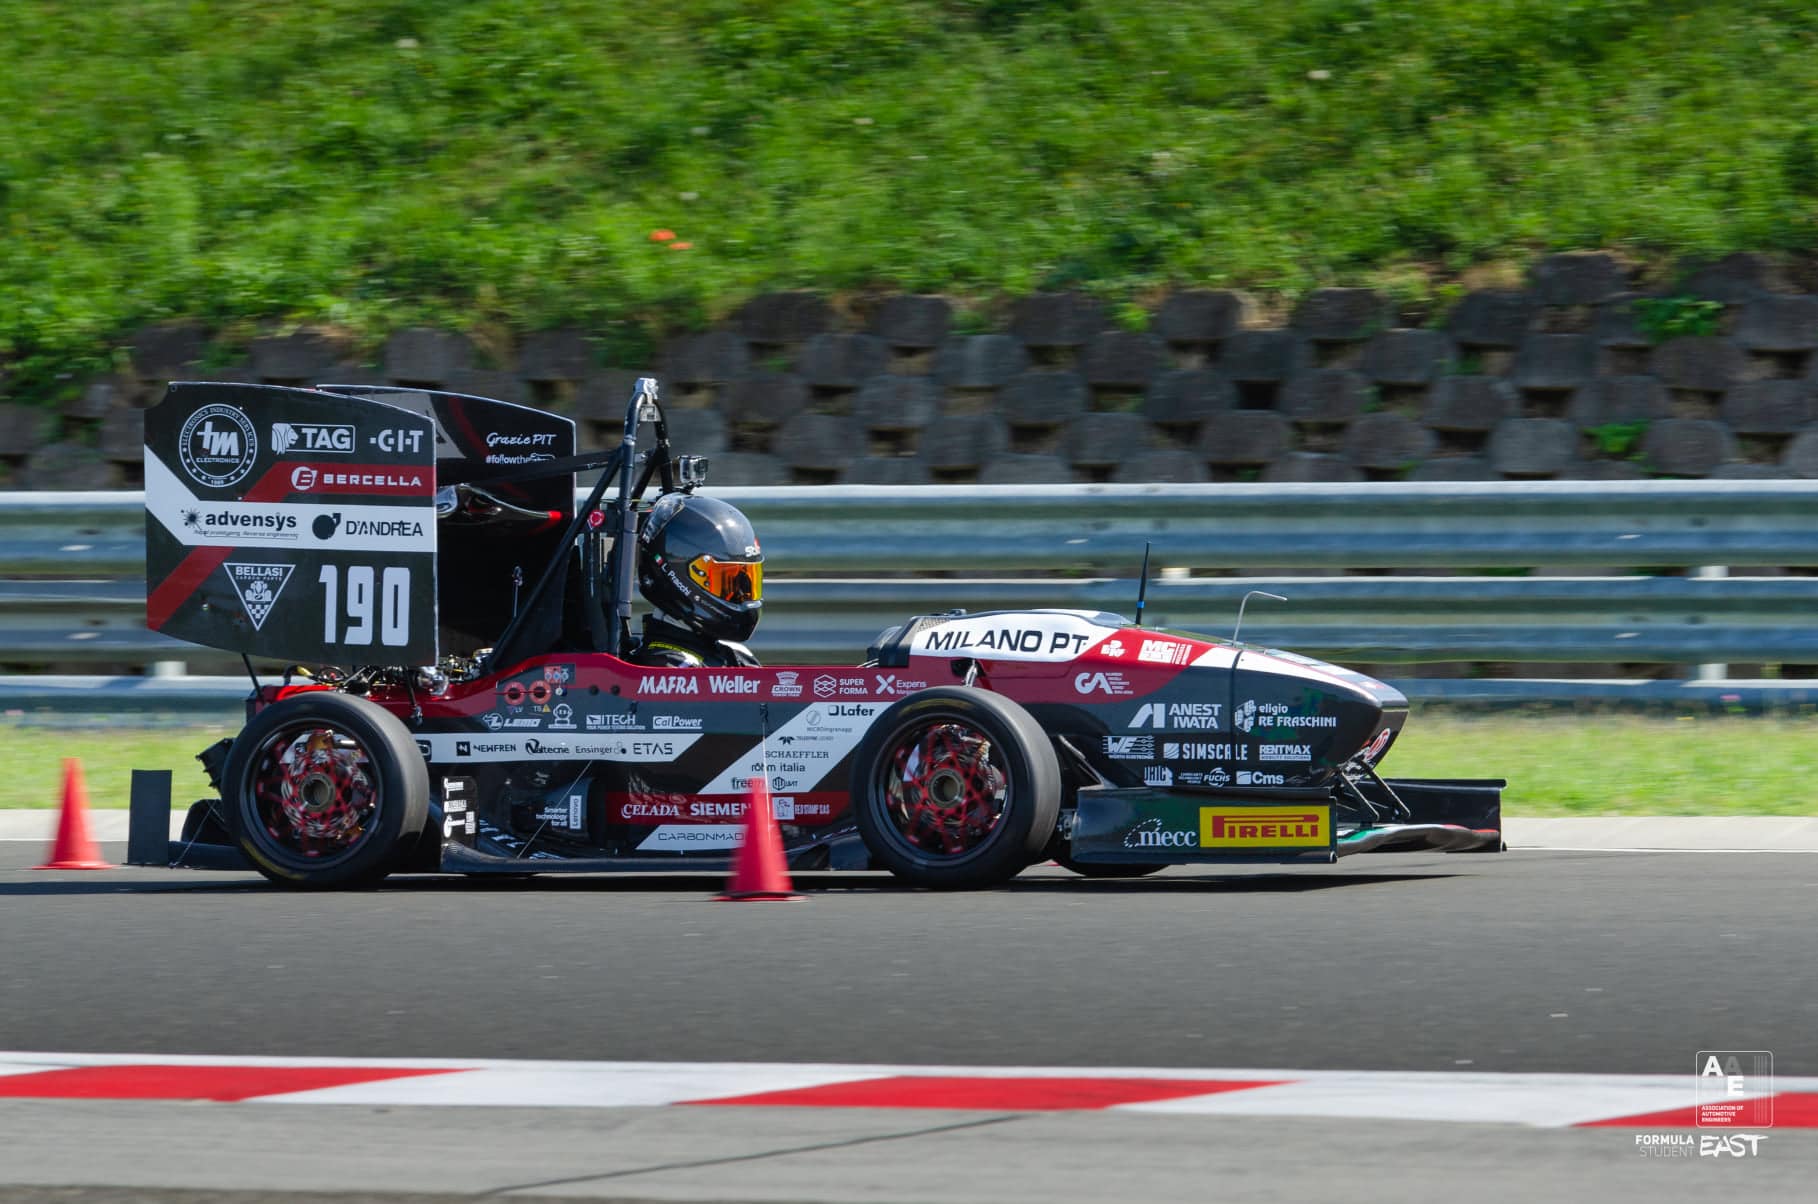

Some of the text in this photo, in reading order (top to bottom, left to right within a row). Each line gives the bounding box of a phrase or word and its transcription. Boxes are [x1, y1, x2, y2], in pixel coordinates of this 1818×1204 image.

[302, 428, 351, 450] TAG
[532, 434, 557, 446] PIT
[322, 473, 422, 487] BERCELLA
[205, 511, 297, 532] advensys
[235, 566, 283, 577] BELLASI
[318, 564, 411, 647] 190
[925, 629, 1043, 653] MILANO
[1049, 632, 1090, 654] PT
[637, 675, 761, 695] MAFRA Weller
[839, 678, 865, 686] SUPER
[839, 687, 868, 695] FORMA
[841, 704, 875, 717] Lafer
[1168, 703, 1222, 717] ANEST
[1258, 703, 1289, 717] eligio
[503, 718, 542, 728] LEMO
[601, 714, 636, 725] ITECH
[1174, 715, 1219, 729] IWATA
[1258, 716, 1337, 728] RE FRASCHINI
[633, 742, 673, 755] ETAS
[1182, 743, 1248, 761] SIMSCALE
[1259, 744, 1311, 755] RENTMAX
[780, 762, 806, 772] italia
[1203, 773, 1230, 782] FUCHS
[1252, 771, 1284, 784] Cms
[621, 803, 680, 819] CELADA
[690, 802, 752, 816] SIEMEN
[1212, 815, 1319, 838] PIRELLI
